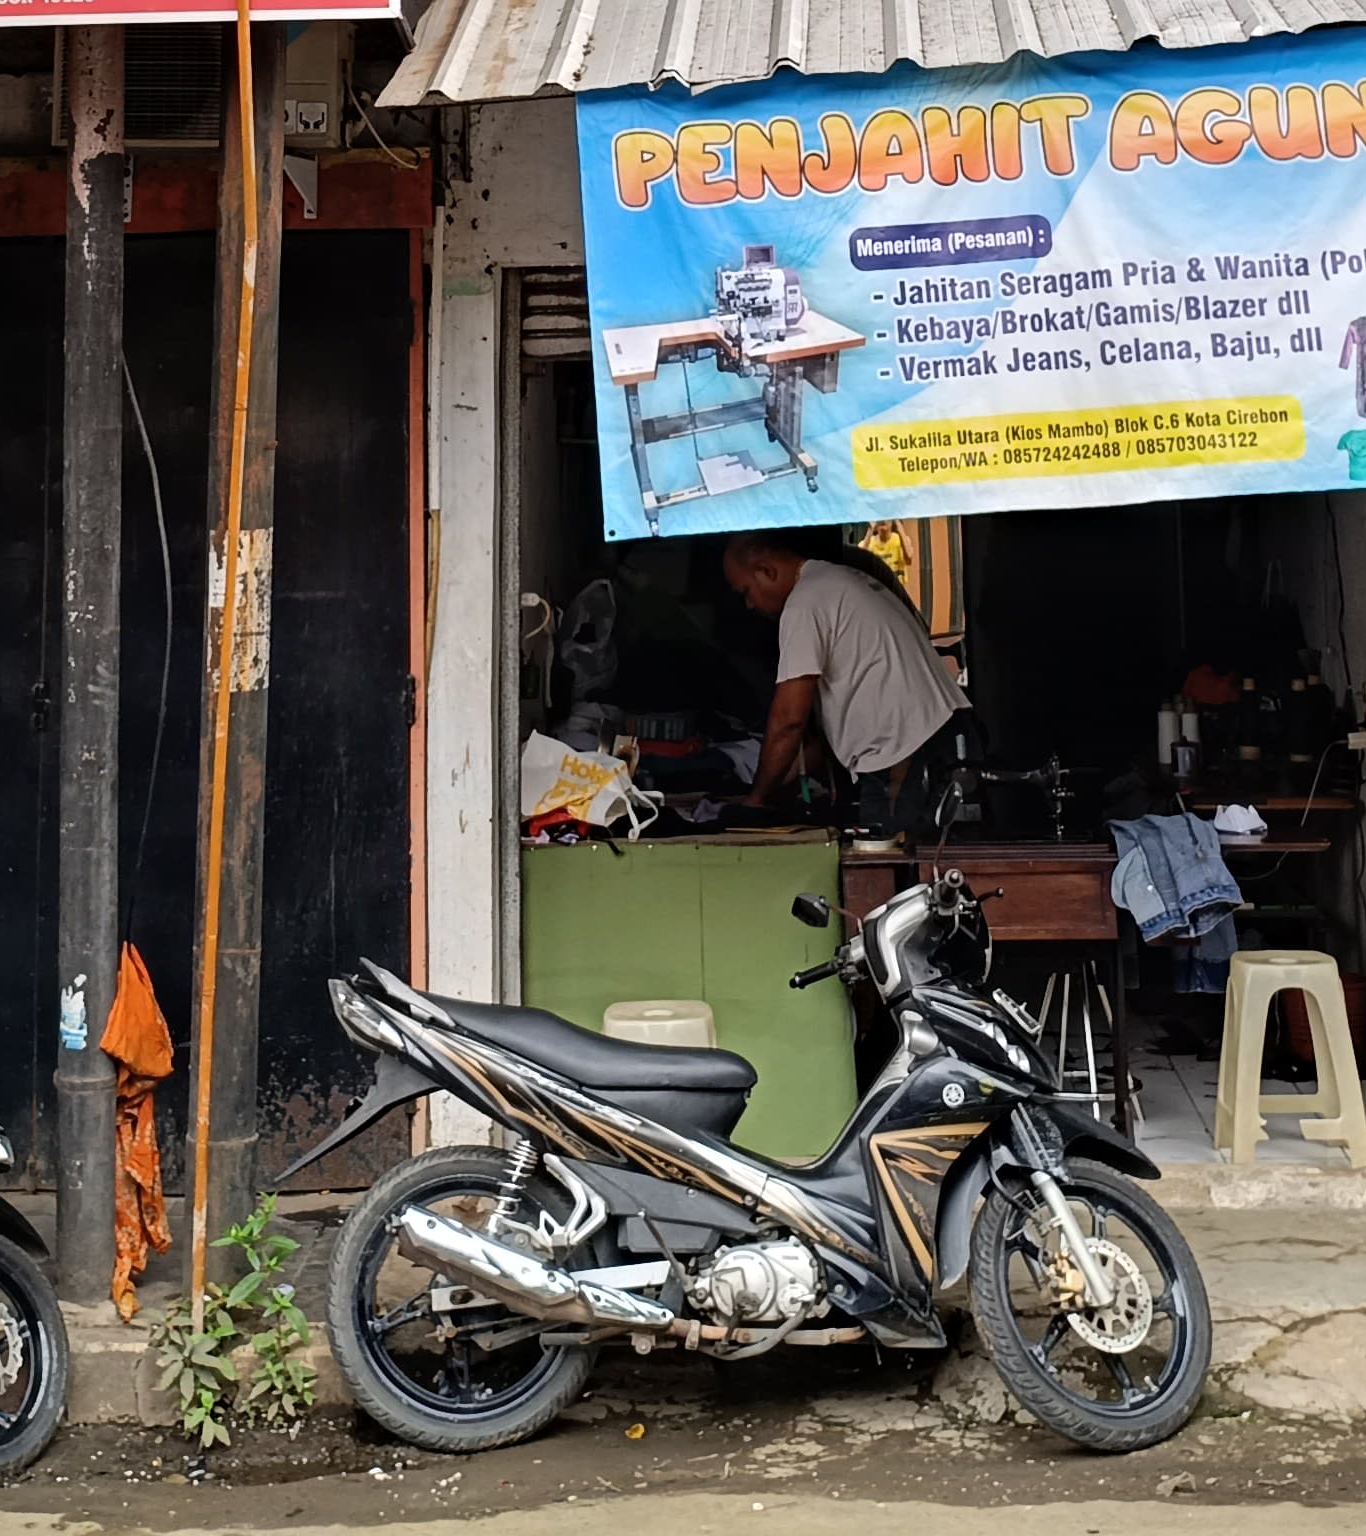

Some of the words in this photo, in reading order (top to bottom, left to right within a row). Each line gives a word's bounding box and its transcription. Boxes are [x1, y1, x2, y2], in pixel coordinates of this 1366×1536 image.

[610, 92, 1094, 209] PENJAHIT
[856, 234, 942, 257] Menerima
[948, 226, 1033, 254] (Pesanan)
[893, 276, 991, 306] Jahitan
[1000, 266, 1112, 299] Seragam
[1123, 260, 1176, 287] Pria
[1187, 257, 1206, 282] &
[1215, 253, 1310, 279] Wanita
[896, 294, 1267, 345] Kebaya/Brokat/Gamis/Blazer
[1278, 290, 1311, 314] dll
[899, 353, 998, 381] Vermak
[1006, 348, 1091, 373] Jeans,
[1100, 337, 1202, 365] Celana,
[1210, 331, 1281, 361] Baju,
[1290, 327, 1324, 353] dll
[866, 437, 883, 452] Jl.
[890, 431, 951, 450] Sukalila
[957, 429, 999, 445] Utara
[1006, 424, 1043, 444] (Kios
[1048, 420, 1109, 439] Mambo)
[1115, 417, 1149, 434] Blok
[1154, 414, 1179, 430] C.6
[1186, 412, 1221, 428] Kota
[1226, 408, 1289, 425] Cirebon
[898, 451, 988, 473] Telepon/WA
[1003, 441, 1121, 465] 085724242488
[1136, 431, 1258, 456] 085703043122
